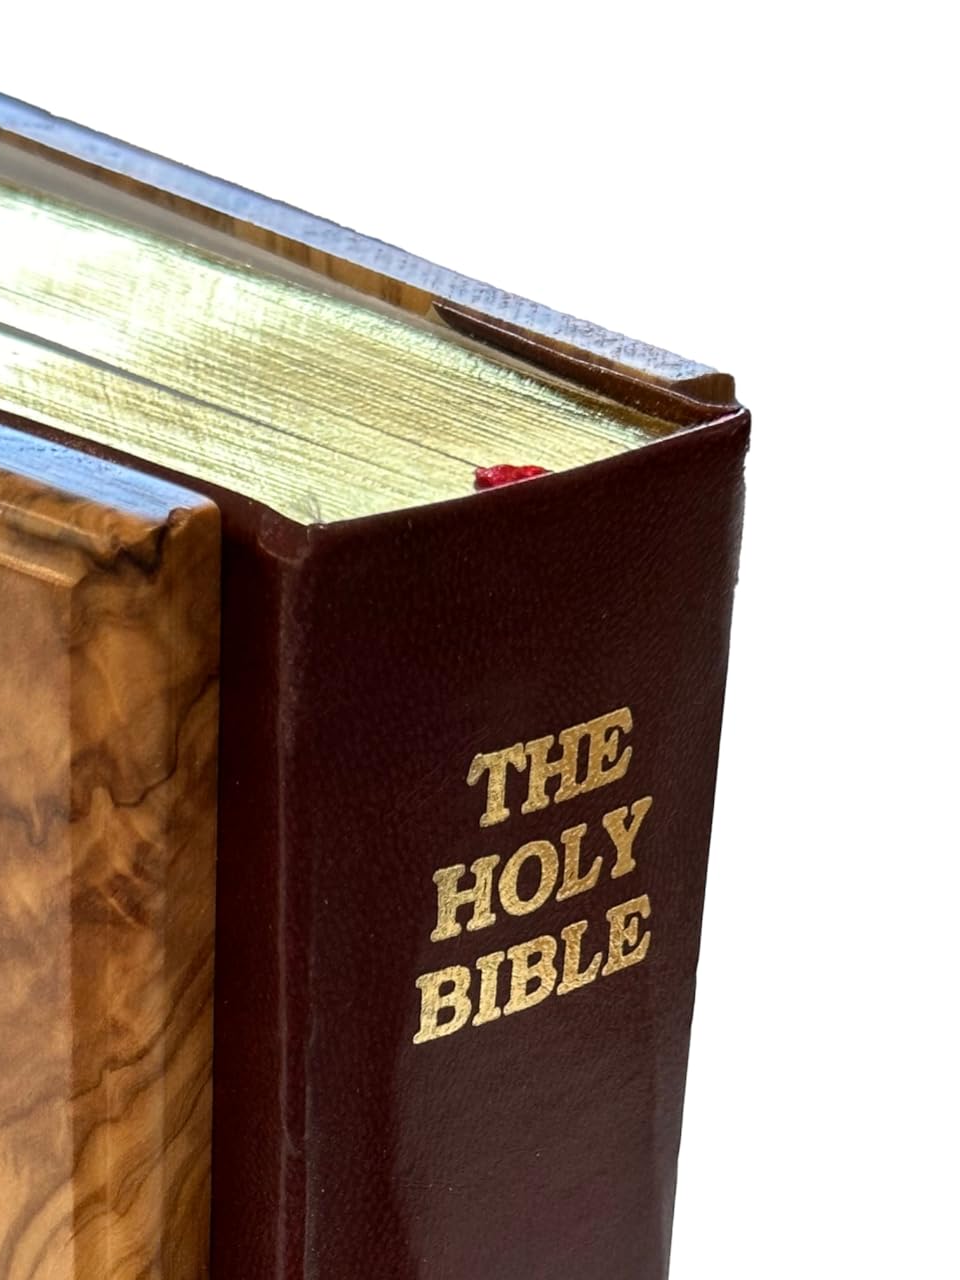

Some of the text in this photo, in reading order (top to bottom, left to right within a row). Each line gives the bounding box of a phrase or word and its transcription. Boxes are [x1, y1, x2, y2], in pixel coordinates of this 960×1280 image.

[466, 707, 633, 827] THE
[430, 796, 652, 942] HOLY
[413, 894, 652, 1044] BIBLE
